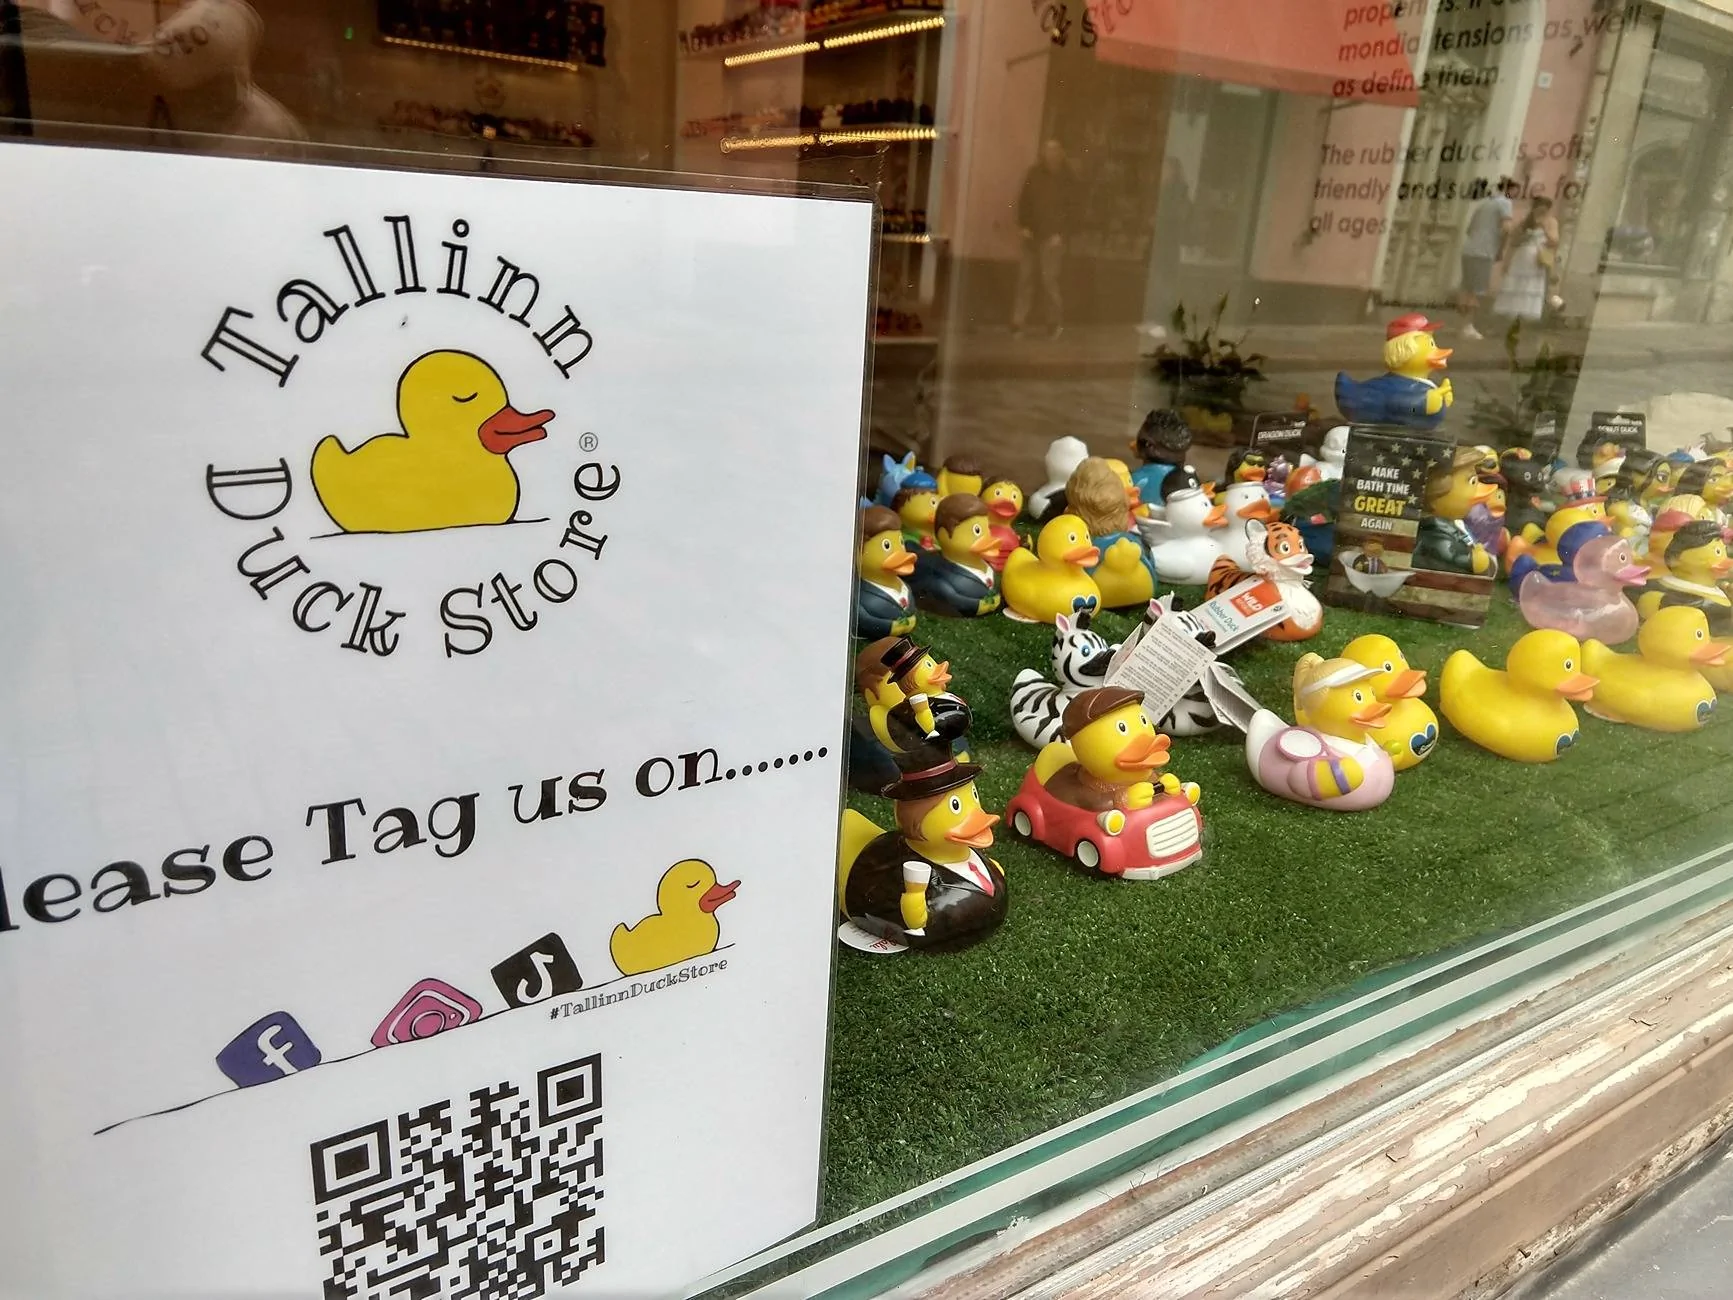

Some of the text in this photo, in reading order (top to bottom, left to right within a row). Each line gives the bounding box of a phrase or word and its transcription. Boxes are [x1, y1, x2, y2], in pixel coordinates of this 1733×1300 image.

[1434, 20, 1534, 51] tensions
[1543, 19, 1573, 39] as
[1583, 5, 1643, 36] well
[1332, 77, 1355, 97] as
[1321, 143, 1356, 165] The
[1360, 141, 1433, 165] rubber
[1440, 138, 1503, 162] duck
[1314, 177, 1391, 205] friendly
[1398, 176, 1441, 200] and
[1309, 210, 1334, 233] all
[201, 215, 593, 387] Tallinn
[1371, 466, 1400, 480] MAKE
[1356, 479, 1410, 496] BATH TIME
[1354, 495, 1406, 516] GREAT
[1361, 517, 1393, 531] AGAIN
[206, 457, 621, 658] Duck Store
[1242, 591, 1264, 612] WILD
[1208, 601, 1228, 620] Rubber
[1223, 617, 1240, 632] Duck
[306, 792, 480, 866] Tag
[508, 768, 608, 824] us
[550, 959, 728, 1020] #TallinnDuckStore
